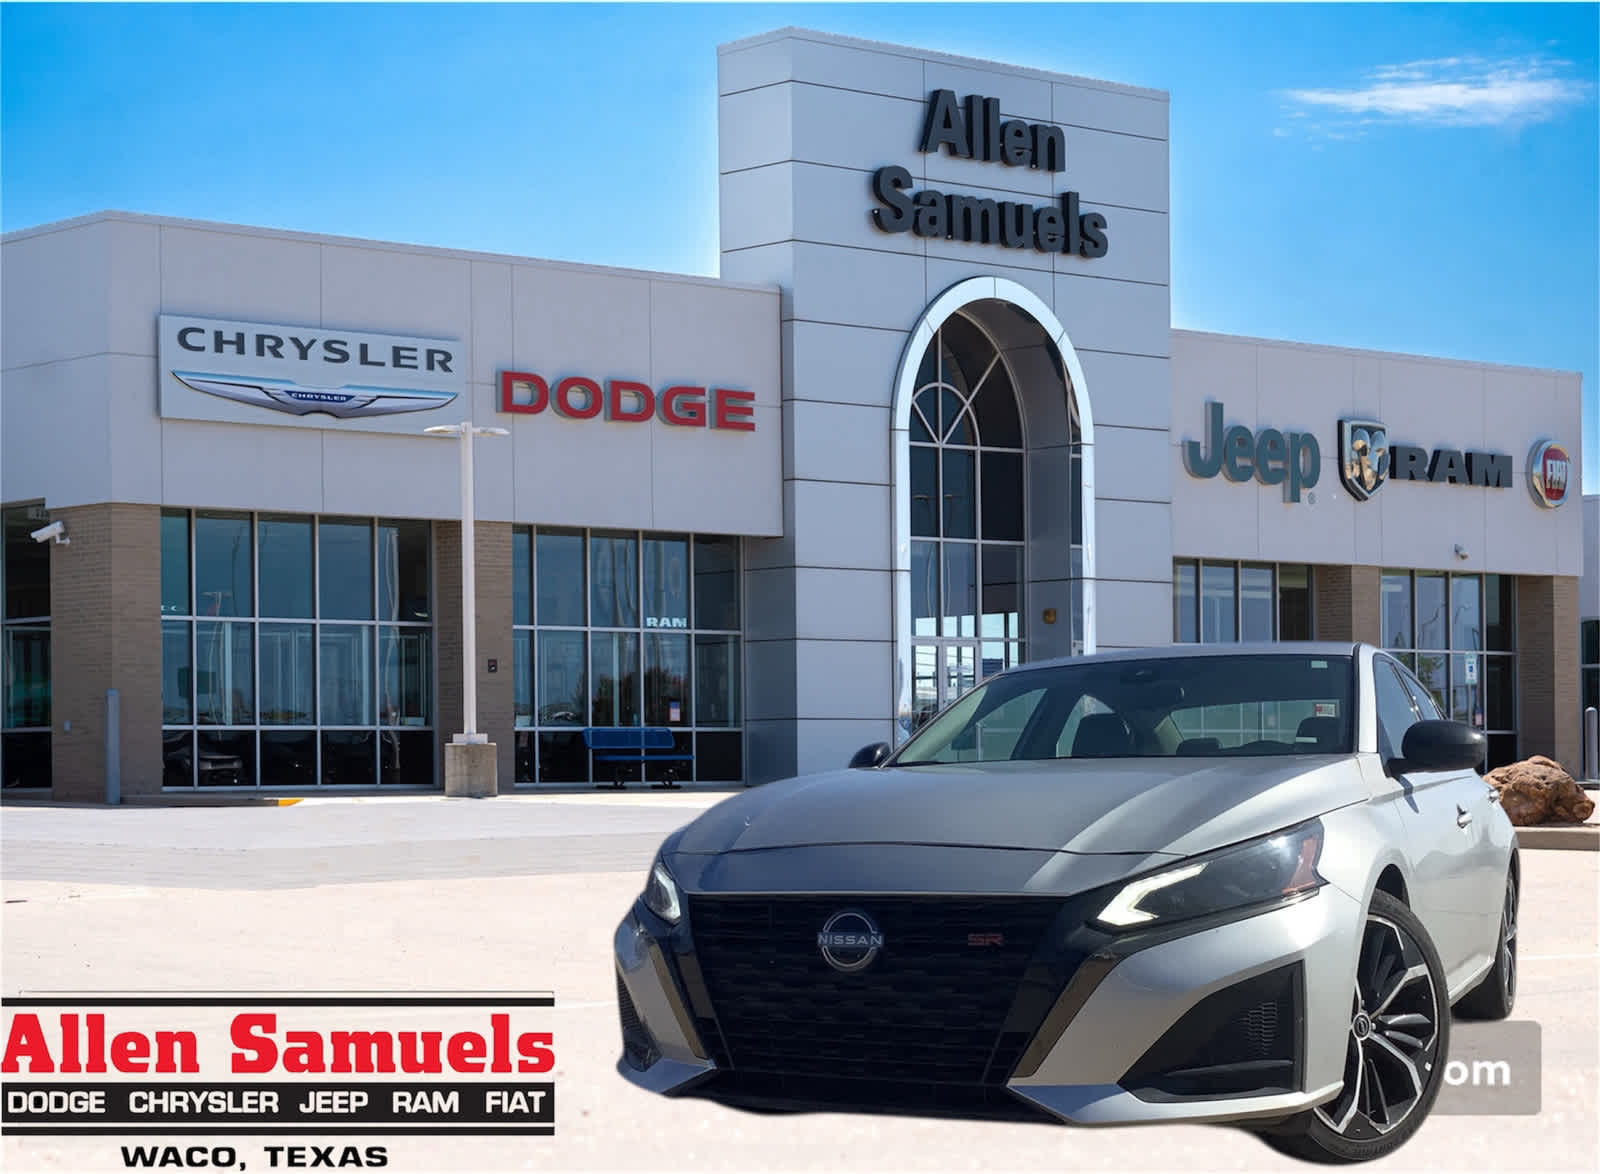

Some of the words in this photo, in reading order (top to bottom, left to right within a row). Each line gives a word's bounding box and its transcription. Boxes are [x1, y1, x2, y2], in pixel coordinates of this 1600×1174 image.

[918, 88, 1066, 172] Allen
[872, 165, 1109, 258] Samuels
[177, 326, 454, 373] CHRYSLER
[291, 391, 347, 402] CHRYSLER
[496, 370, 756, 432] DODGE
[1182, 401, 1321, 503] Jeep
[1389, 445, 1513, 489] RAM
[1546, 459, 1567, 489] FIAT
[646, 616, 687, 628] RAM
[817, 933, 883, 946] NISSAN
[967, 933, 1004, 946] SR
